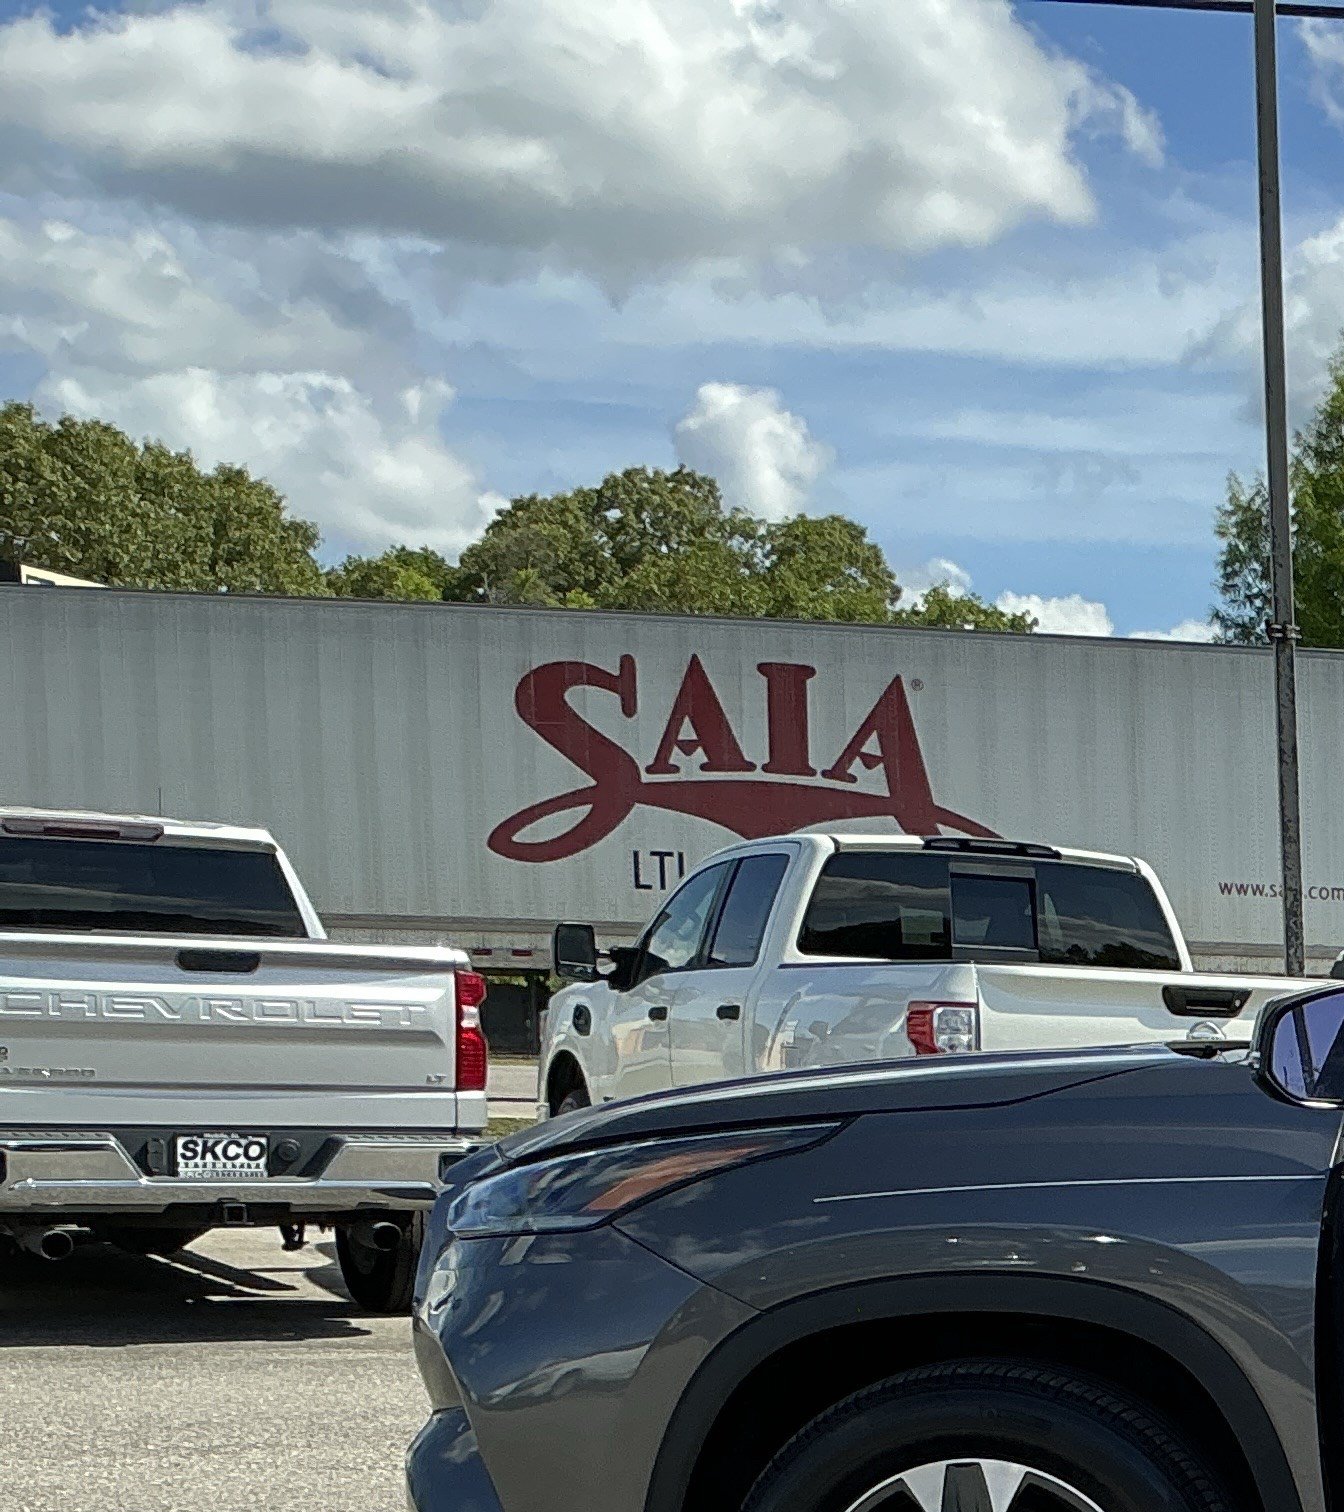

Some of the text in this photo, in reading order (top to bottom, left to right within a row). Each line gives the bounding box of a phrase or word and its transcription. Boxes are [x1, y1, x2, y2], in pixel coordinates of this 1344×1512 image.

[487, 653, 1005, 862] SAIA
[0, 991, 428, 1026] CHEVROLET
[179, 1139, 267, 1162] SKCO
